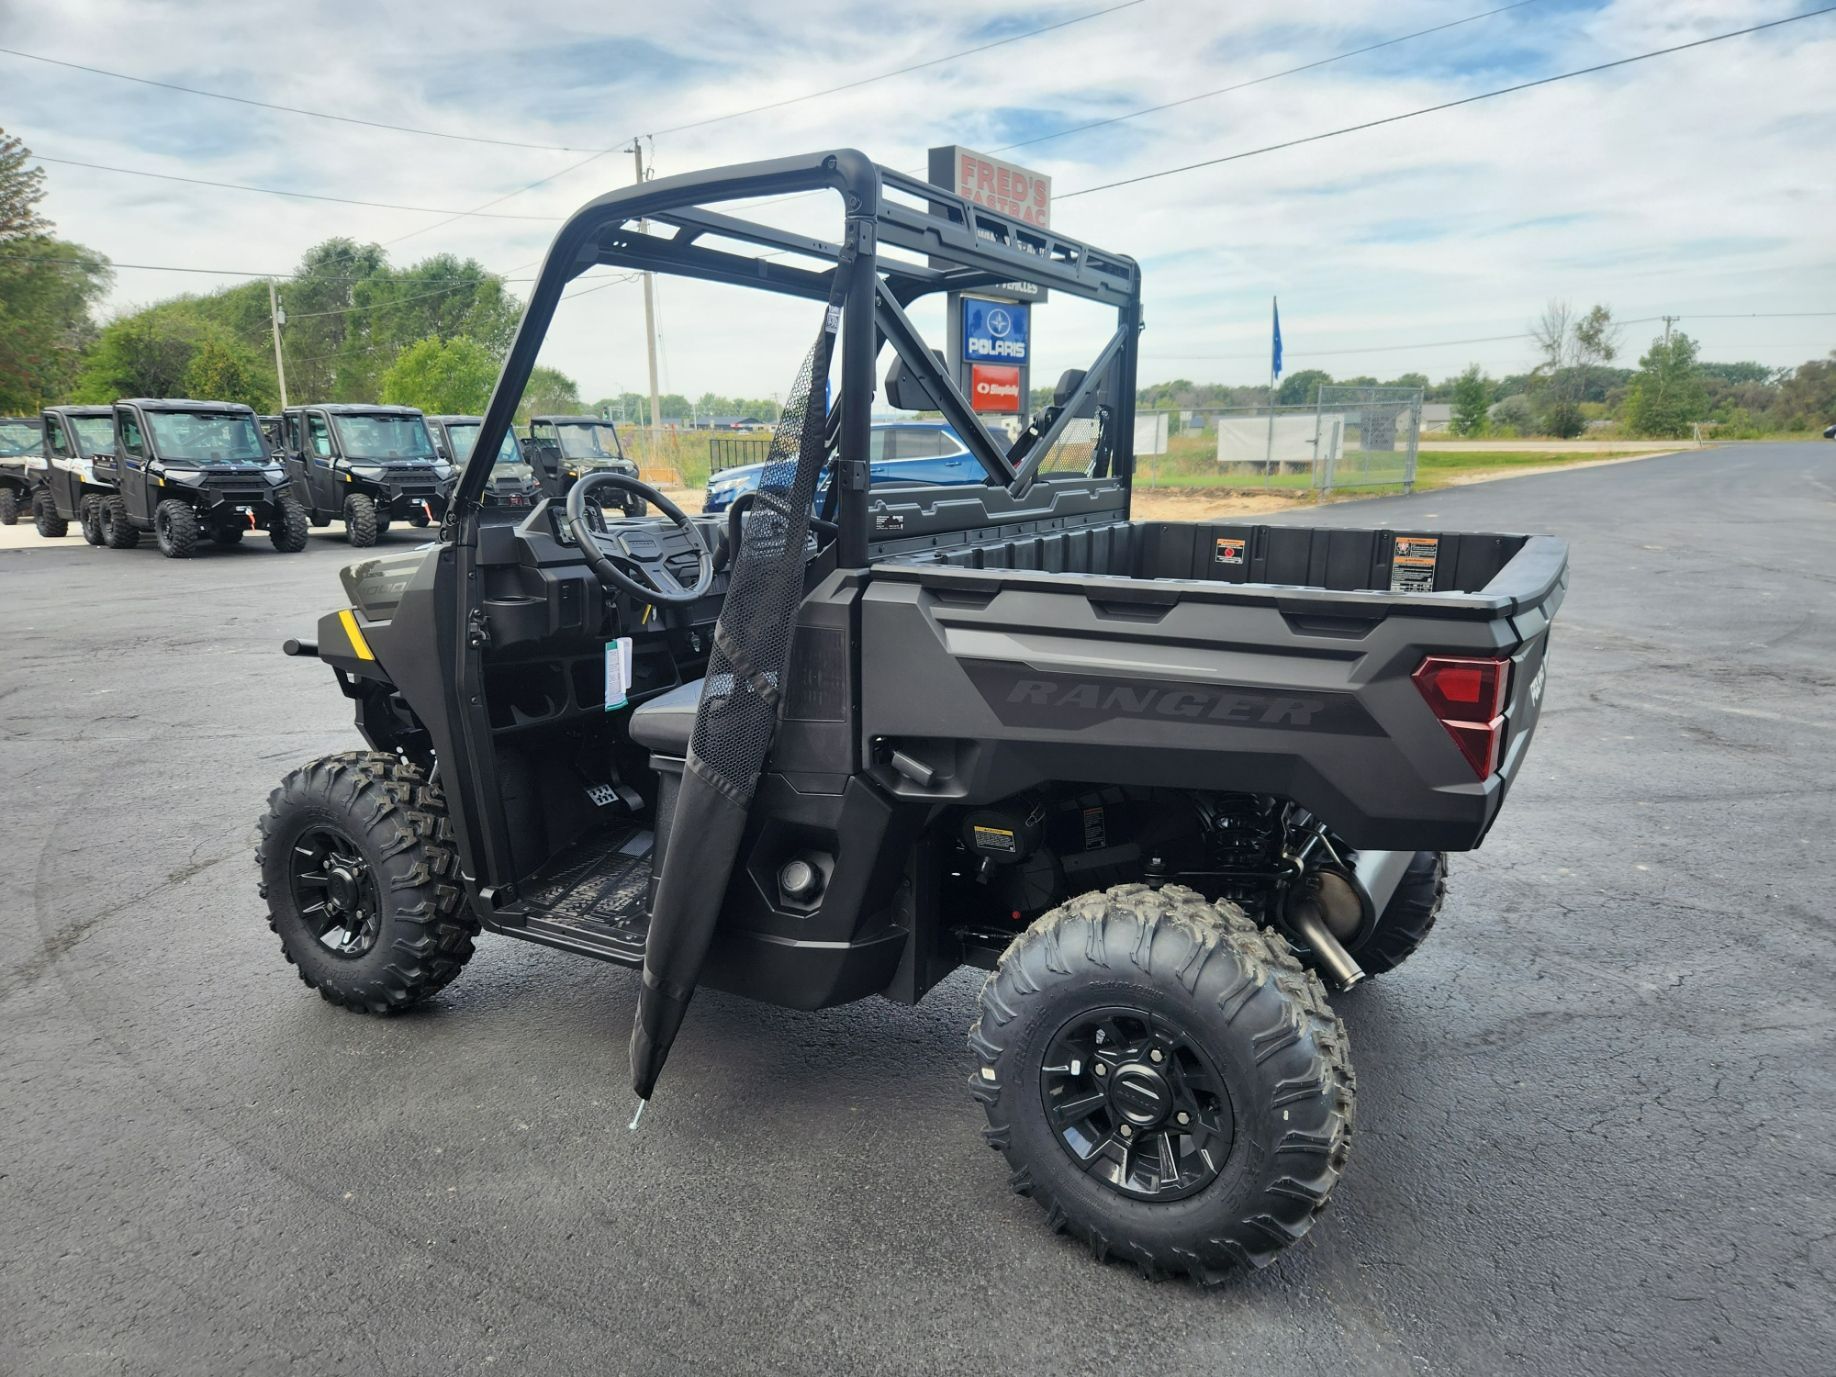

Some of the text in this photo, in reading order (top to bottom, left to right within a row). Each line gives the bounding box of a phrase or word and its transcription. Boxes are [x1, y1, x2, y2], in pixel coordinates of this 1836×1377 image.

[960, 154, 1047, 208] FRED'S
[968, 338, 1026, 358] POLARIS
[1007, 680, 1325, 725] RANGER
